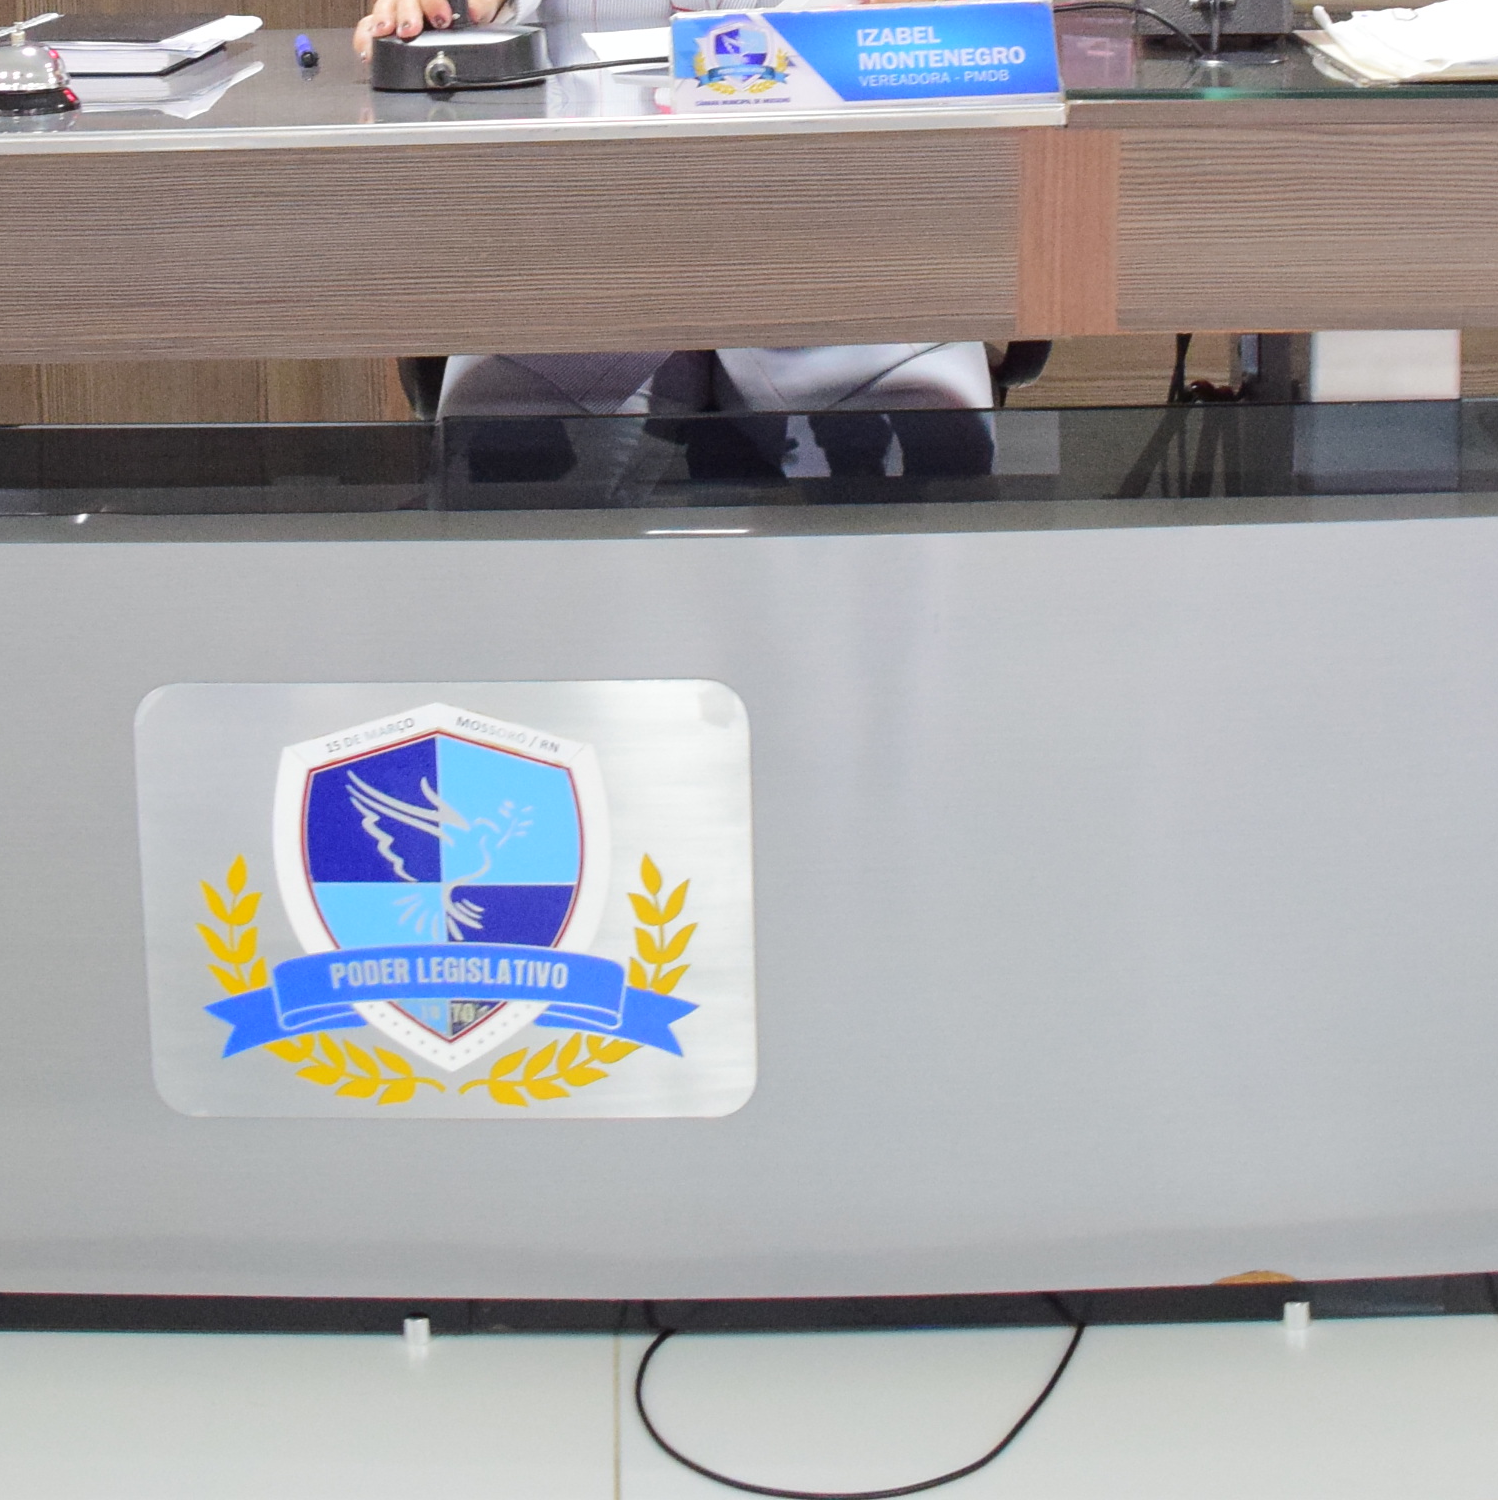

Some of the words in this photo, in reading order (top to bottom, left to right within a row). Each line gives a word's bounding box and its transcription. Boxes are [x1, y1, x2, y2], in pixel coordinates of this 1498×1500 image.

[856, 26, 941, 47] IZABEL
[859, 46, 1026, 70] MONTENEGRO
[858, 71, 951, 87] VEREADORA
[964, 70, 1010, 82] PMDB
[325, 741, 342, 753] 15
[343, 734, 361, 749] DE
[539, 739, 561, 754] RN
[329, 957, 411, 990] PODER
[416, 956, 570, 990] LEGISLATIVO
